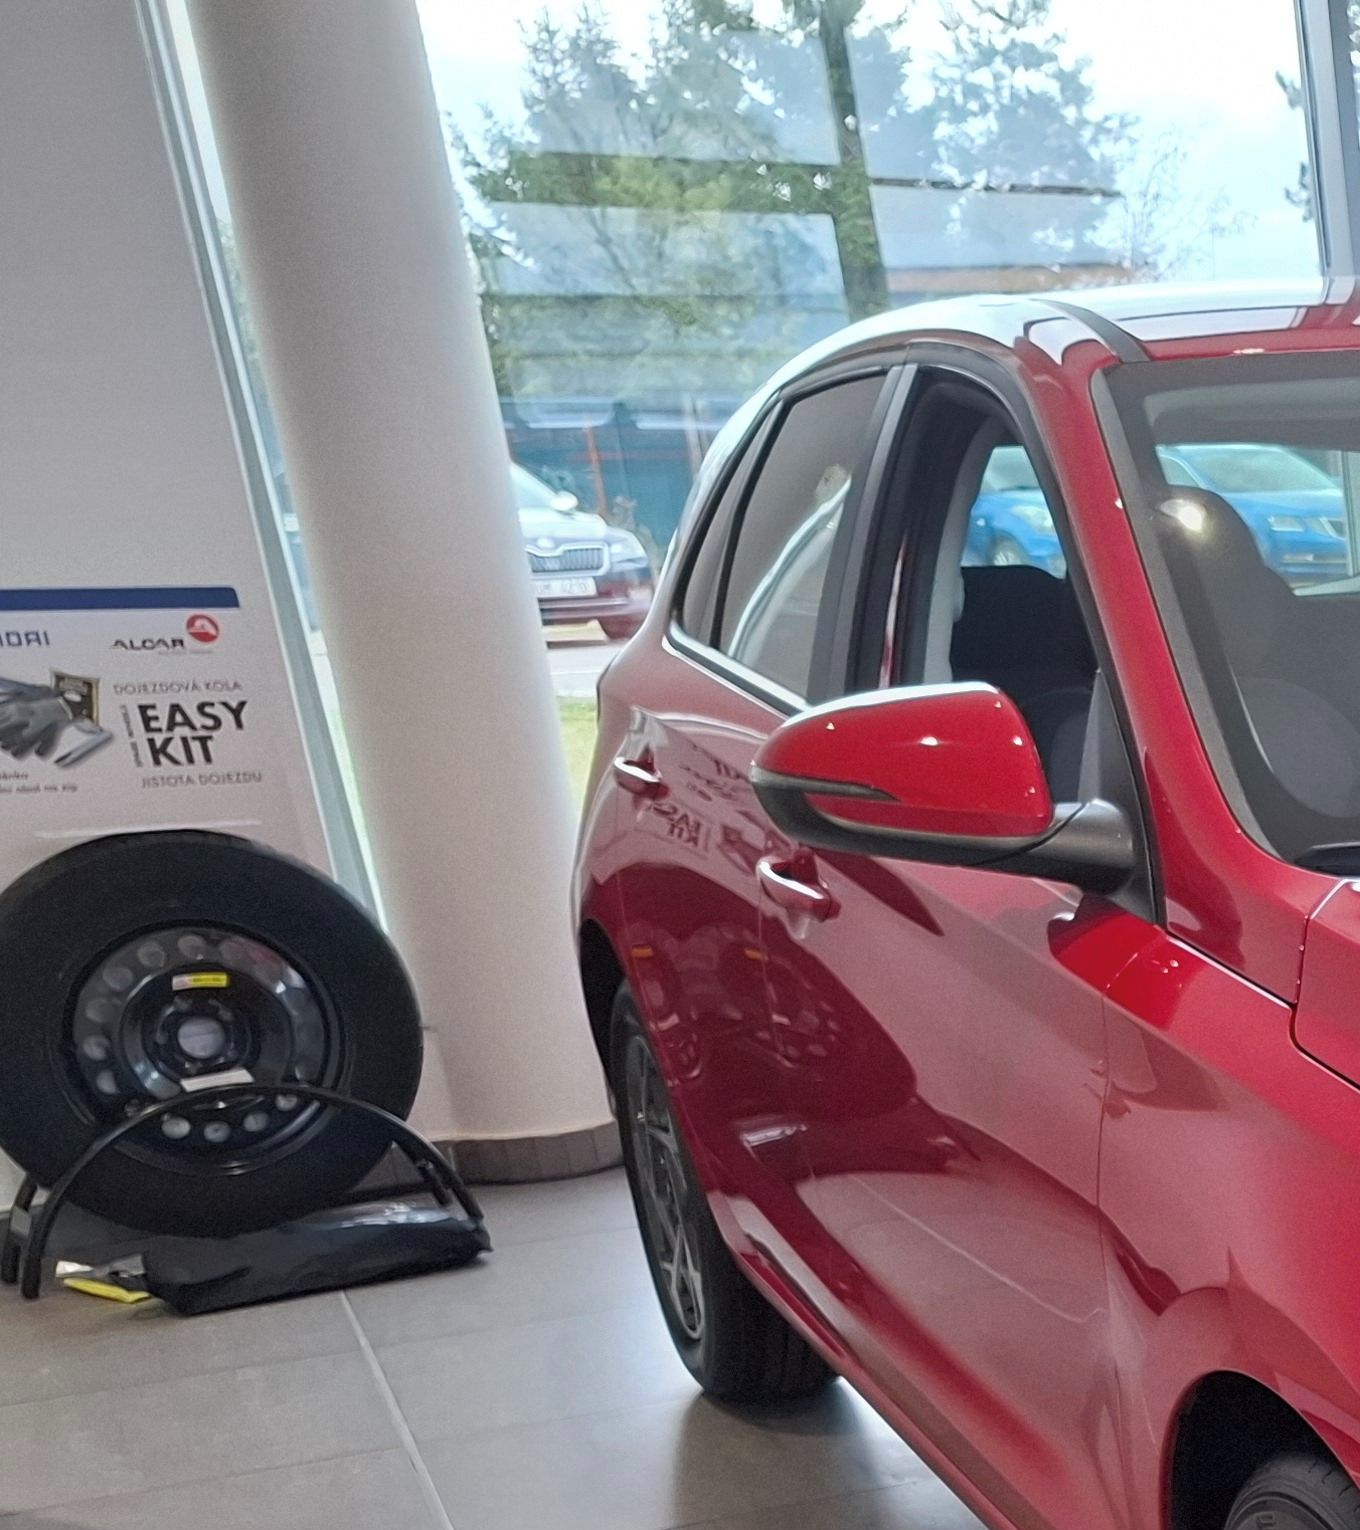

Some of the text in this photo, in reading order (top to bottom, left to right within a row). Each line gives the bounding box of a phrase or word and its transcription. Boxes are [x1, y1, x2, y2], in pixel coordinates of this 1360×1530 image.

[112, 637, 186, 651] ALCAR
[204, 680, 243, 692] KOLA
[137, 700, 248, 734] EASY
[146, 735, 214, 767] KIT
[142, 772, 262, 789] JISTOTA DOJEZDU
